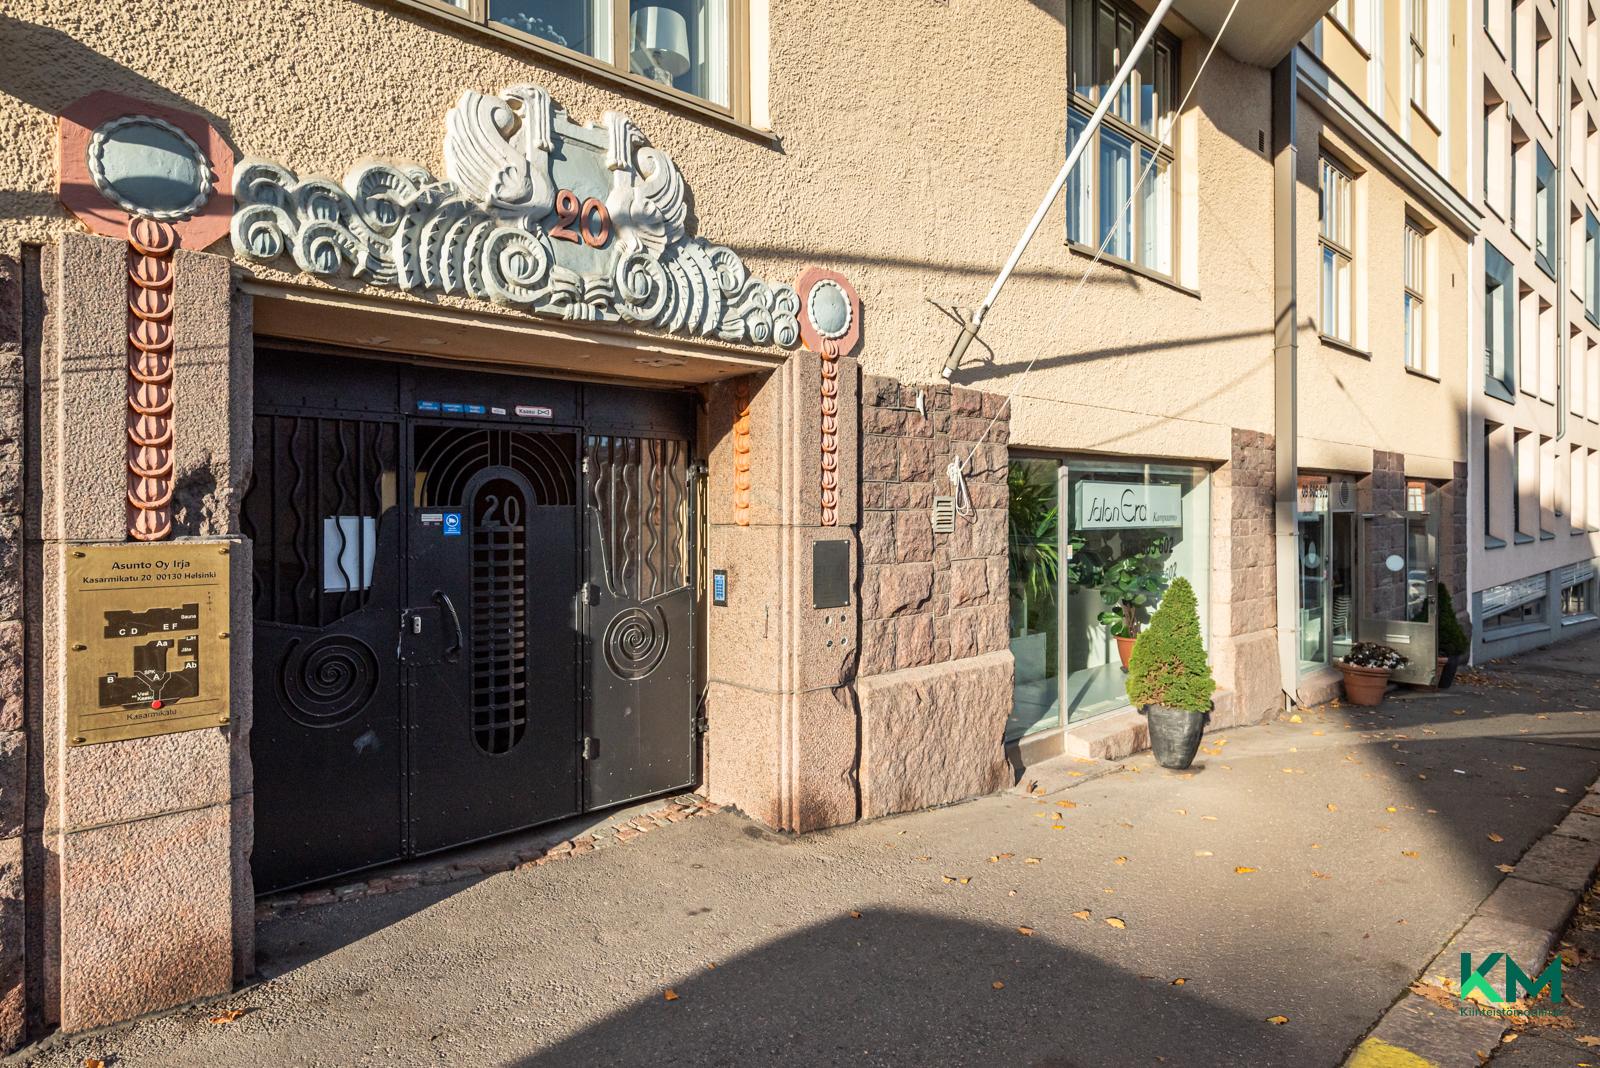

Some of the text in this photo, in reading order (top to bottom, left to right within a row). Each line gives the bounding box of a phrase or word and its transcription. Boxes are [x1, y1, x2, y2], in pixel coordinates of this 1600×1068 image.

[548, 188, 610, 248] 20
[481, 494, 520, 527] 20
[1088, 488, 1147, 523] Salon Era
[111, 560, 190, 571] Asunto Oy Irja
[82, 572, 217, 584] Kasarmikatu 20 00130 Helsinki
[119, 628, 126, 636] C
[163, 622, 178, 631] E F
[185, 661, 197, 669] Ab
[107, 676, 114, 684] B
[126, 709, 177, 721] Kasarmikatu
